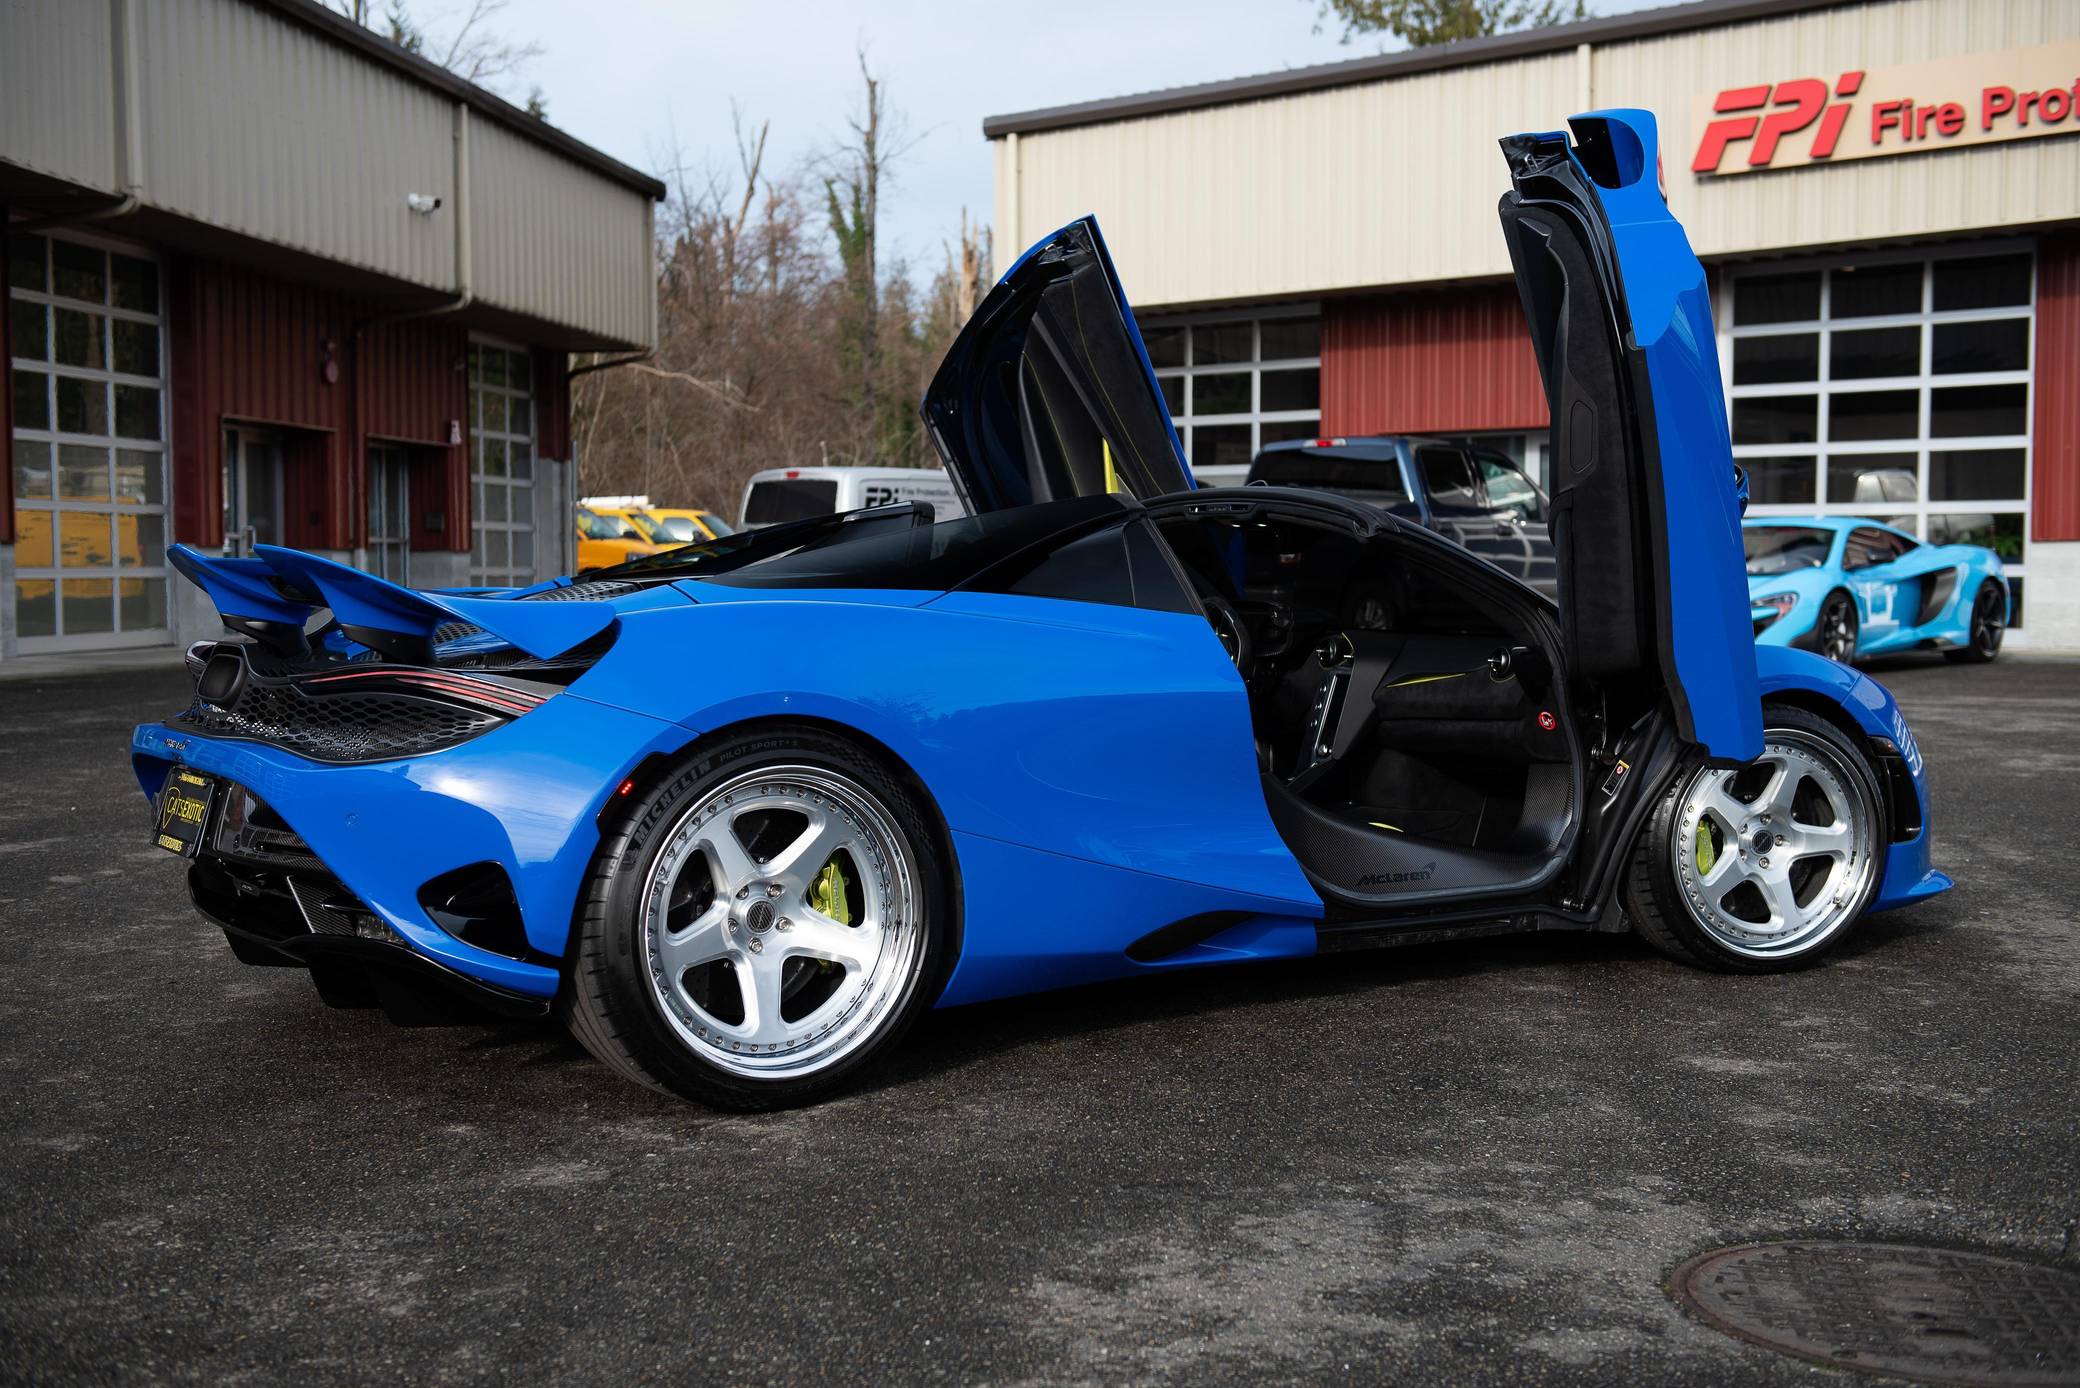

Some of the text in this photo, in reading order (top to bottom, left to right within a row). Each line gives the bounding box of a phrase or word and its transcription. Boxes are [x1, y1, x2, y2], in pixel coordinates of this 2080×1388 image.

[1871, 99, 1965, 145] Fire
[719, 746, 748, 763] PILOT
[751, 740, 785, 752] SPORT
[634, 759, 713, 846] MICHELIN
[1356, 870, 1432, 886] McLaren
